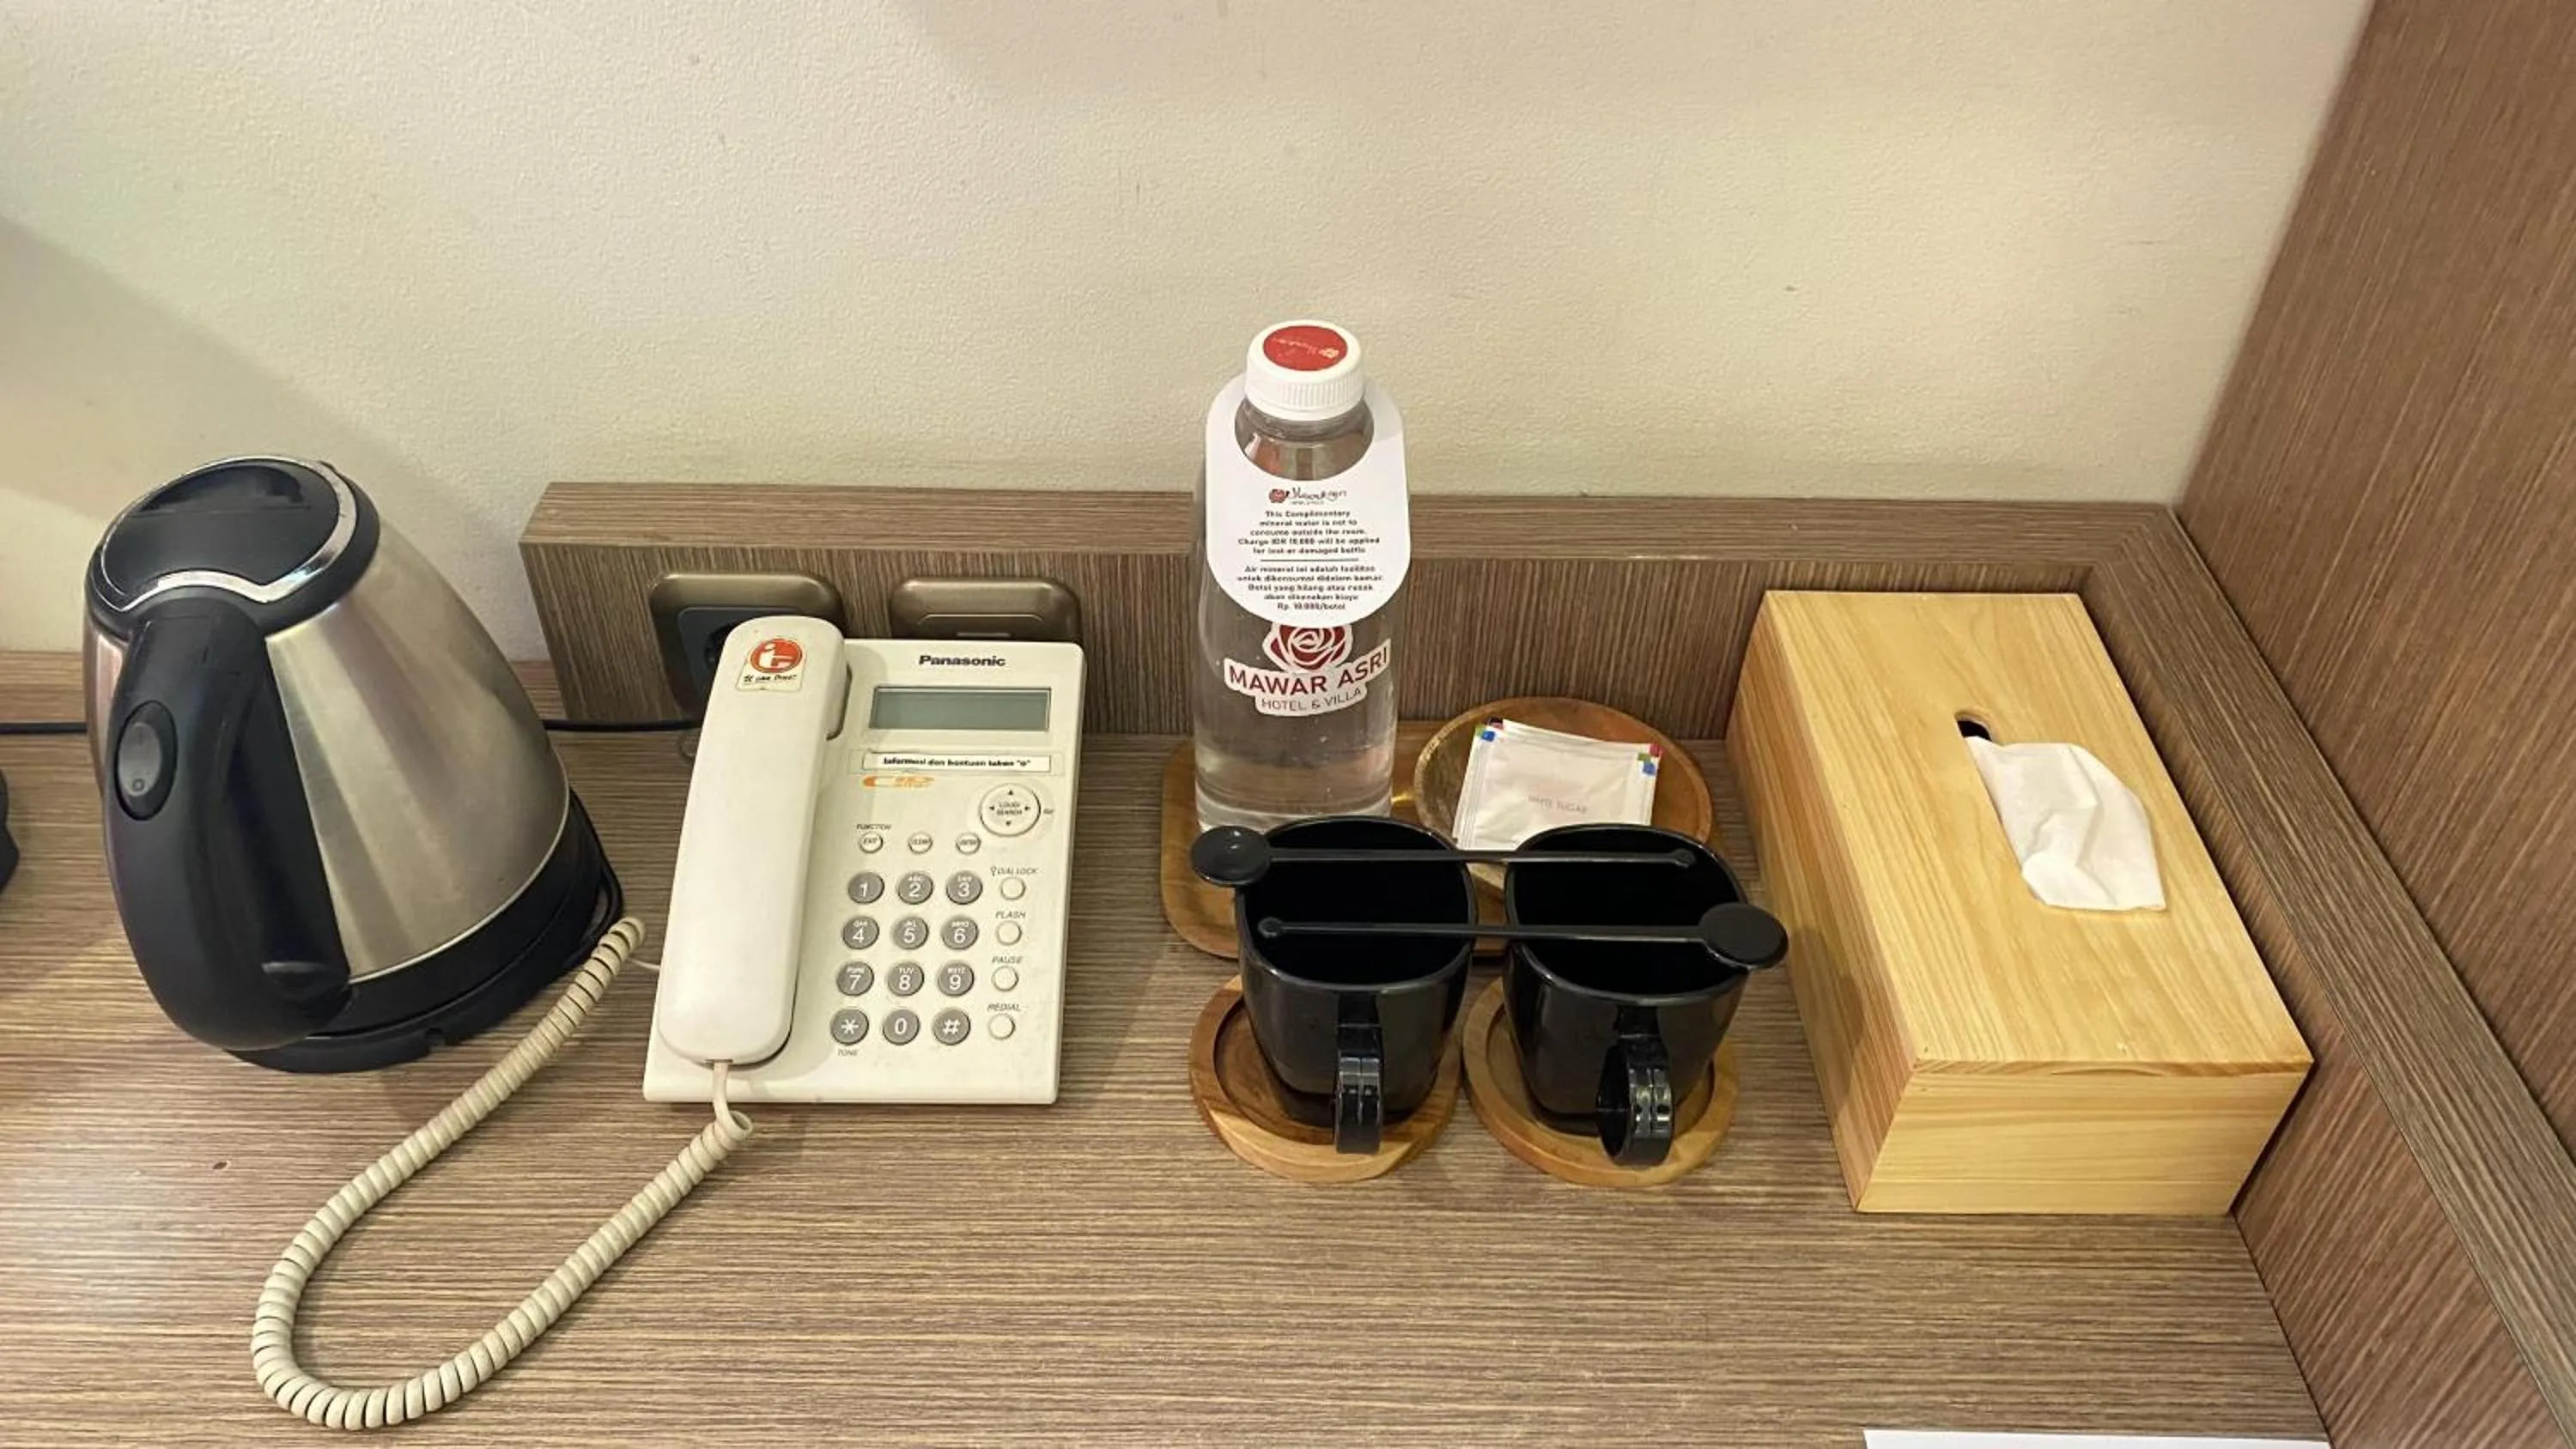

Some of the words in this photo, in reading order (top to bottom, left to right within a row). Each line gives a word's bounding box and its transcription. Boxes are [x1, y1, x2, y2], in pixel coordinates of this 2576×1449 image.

[1237, 537, 1269, 546] Charge
[919, 655, 1006, 667] Panasonic
[1229, 664, 1327, 696] MAWAR
[1337, 647, 1388, 689] ASRI
[1261, 698, 1307, 712] HOTEL
[1311, 700, 1321, 709] &
[1325, 688, 1362, 706] VILLA
[860, 882, 868, 898] 1
[908, 882, 921, 898] 2
[957, 882, 970, 898] 3
[852, 927, 865, 943] 4
[902, 927, 916, 943] 5
[953, 928, 967, 944] 6
[849, 974, 862, 991] 7
[898, 974, 911, 991] 8
[949, 974, 962, 991] 9
[894, 1017, 908, 1035] 0
